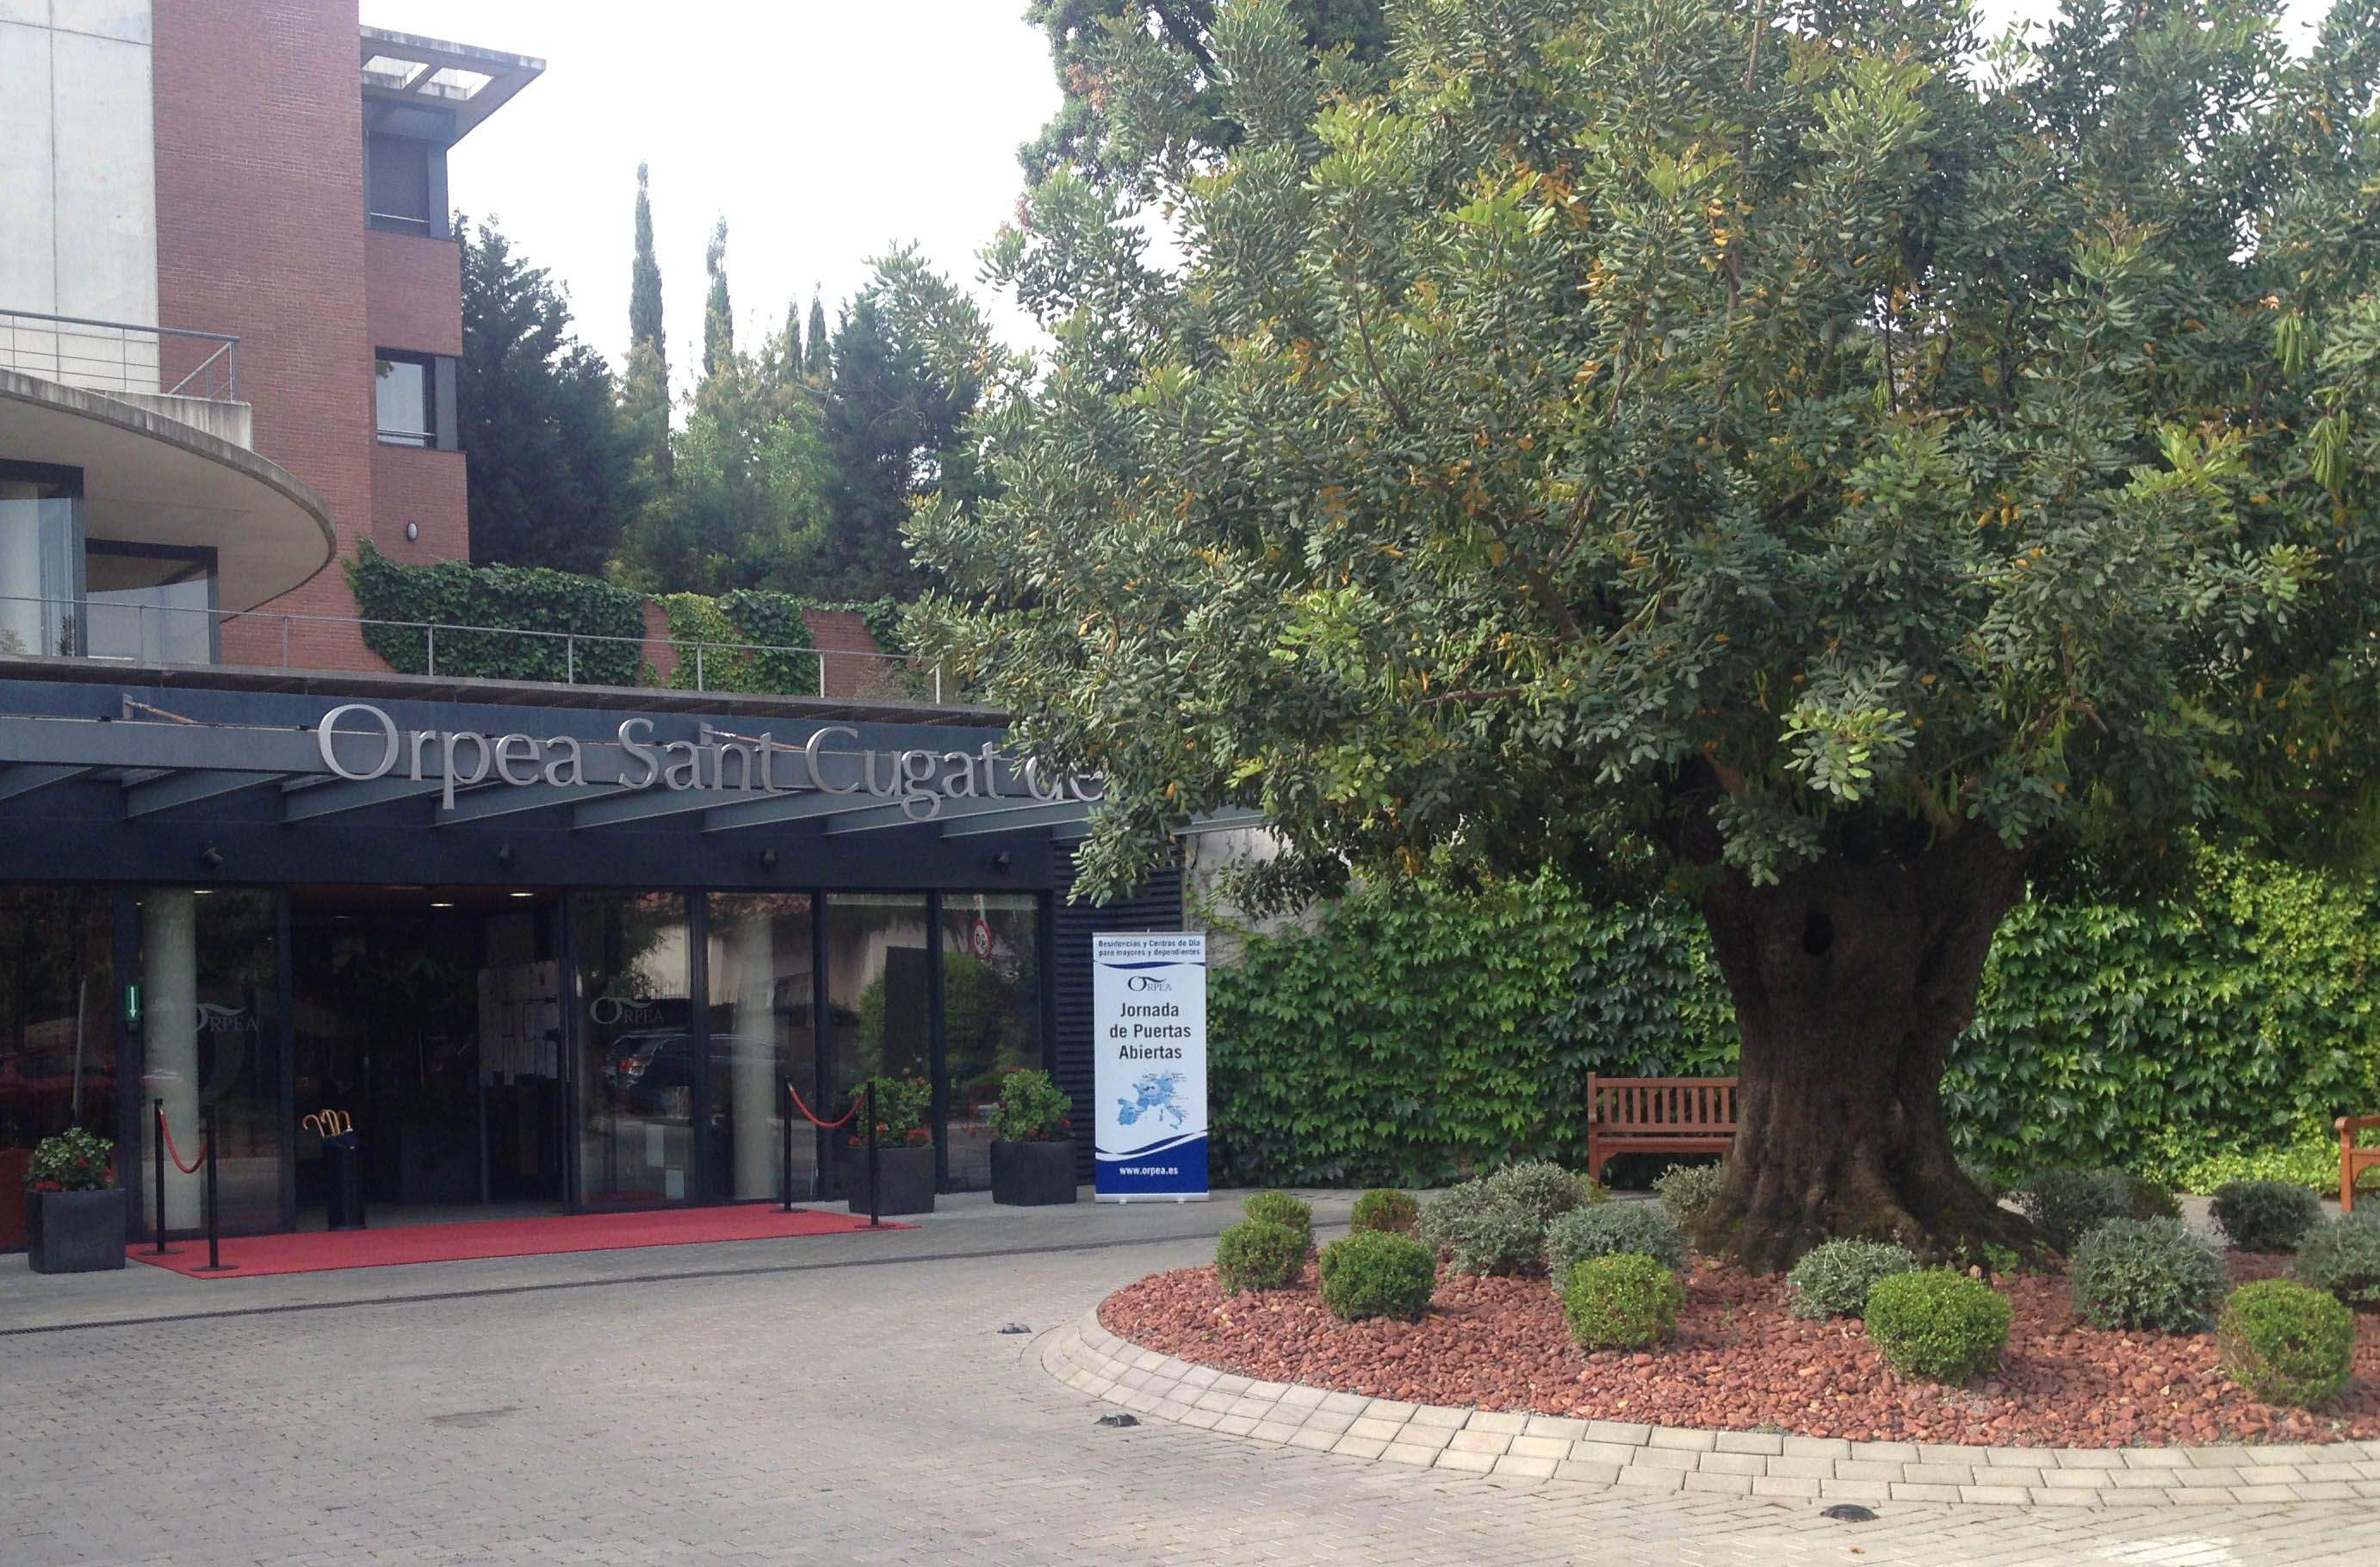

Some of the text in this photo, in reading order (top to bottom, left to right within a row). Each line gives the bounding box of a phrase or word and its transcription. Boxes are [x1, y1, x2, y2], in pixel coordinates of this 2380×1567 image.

[318, 703, 588, 809] Orpea
[618, 717, 778, 794] Sant
[805, 726, 1005, 821] Cugat
[1120, 1002, 1179, 1017] Jornada
[1110, 1024, 1191, 1038] de Puertas
[1119, 1044, 1182, 1060] Abiertas
[1119, 1167, 1179, 1176] www.orpea.es
